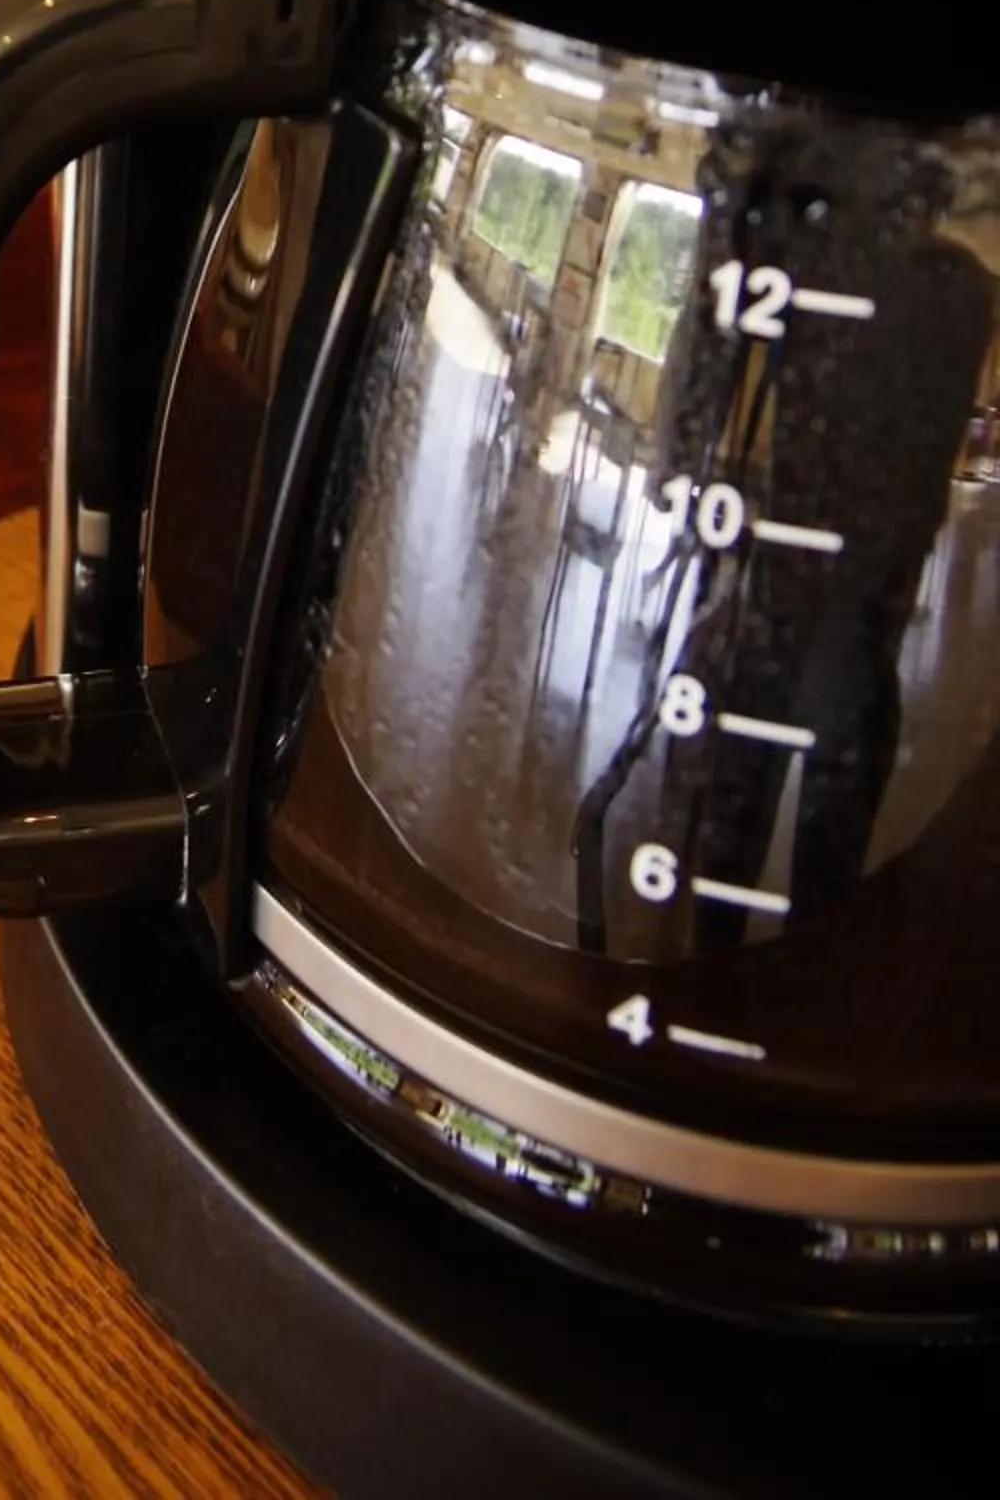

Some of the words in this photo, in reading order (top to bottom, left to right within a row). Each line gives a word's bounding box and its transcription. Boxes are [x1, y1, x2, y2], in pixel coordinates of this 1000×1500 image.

[709, 260, 792, 338] 12
[662, 474, 744, 549] 10
[659, 673, 705, 737] 8
[629, 843, 678, 902] 6
[606, 994, 653, 1047] 4
